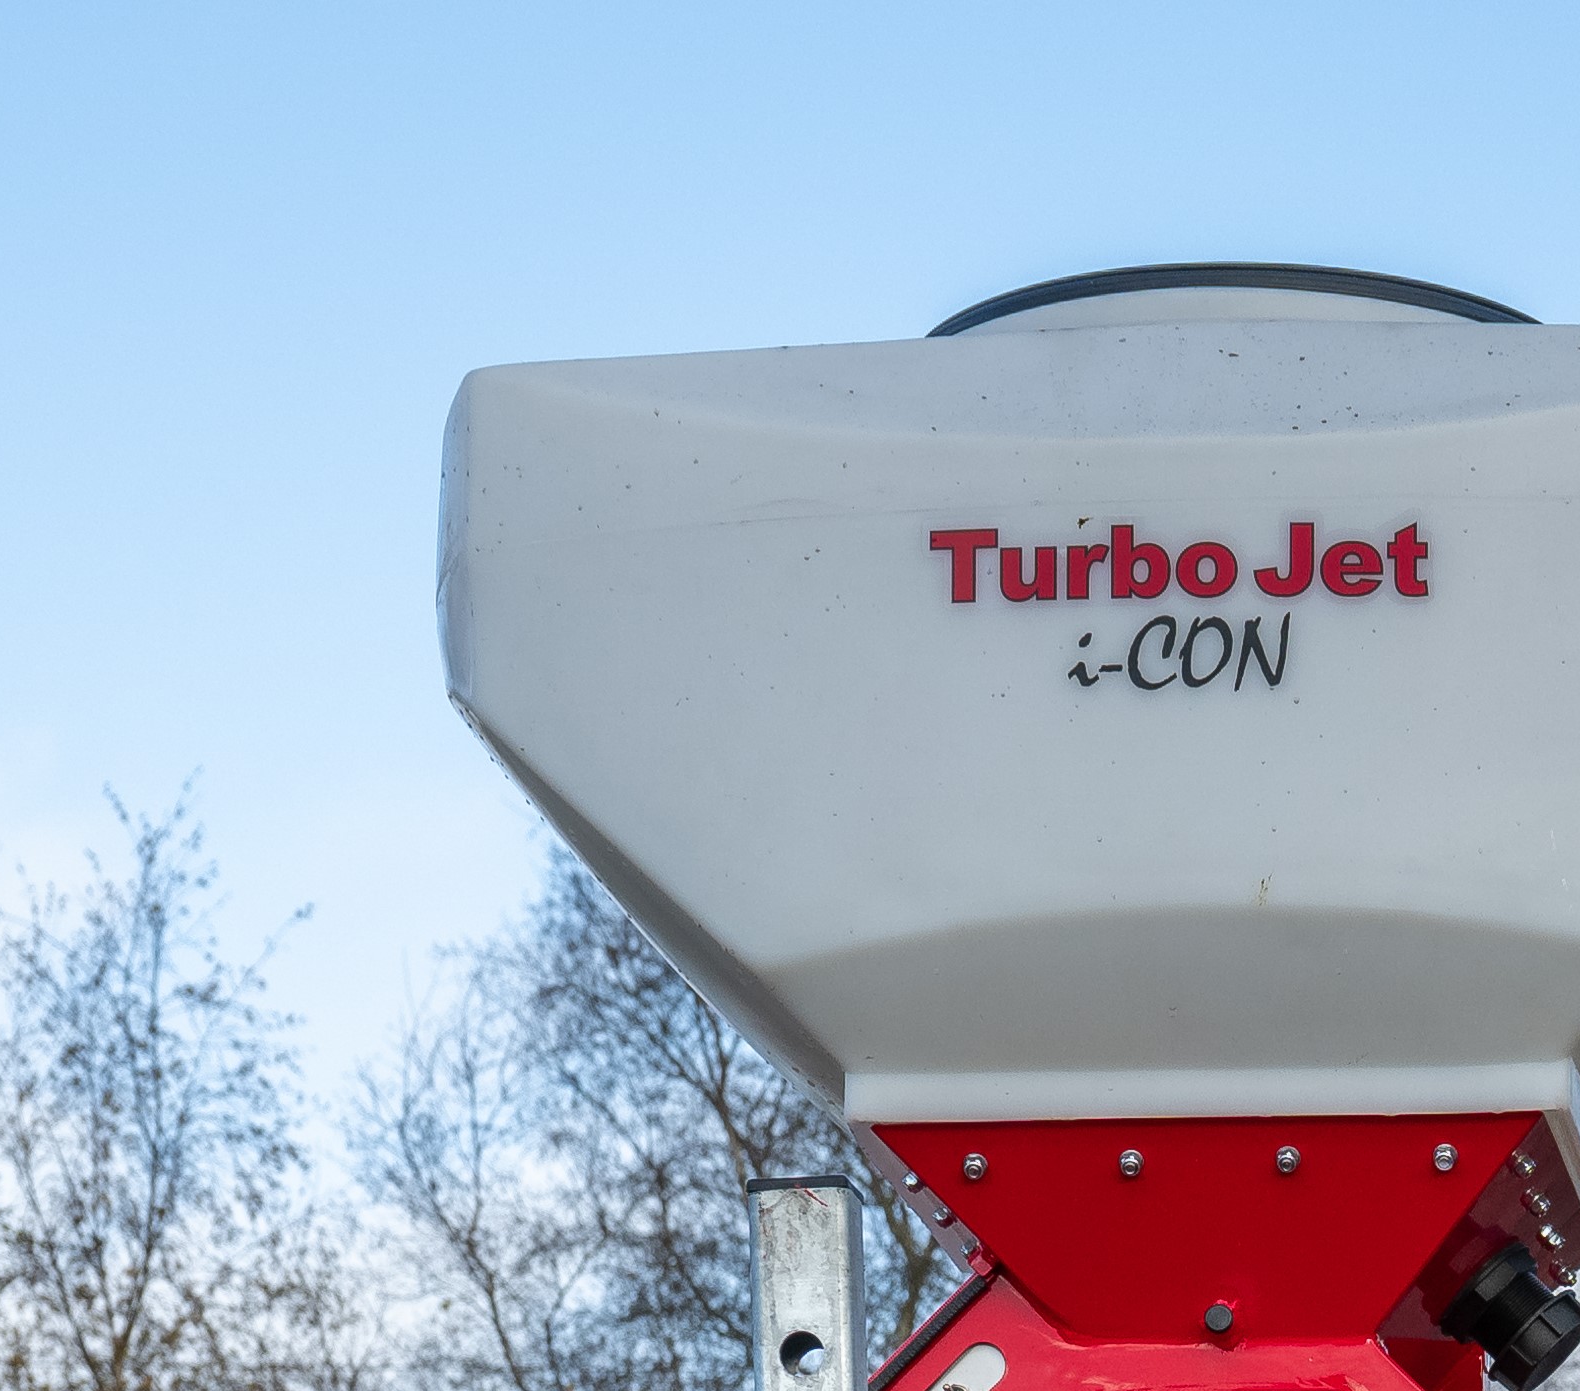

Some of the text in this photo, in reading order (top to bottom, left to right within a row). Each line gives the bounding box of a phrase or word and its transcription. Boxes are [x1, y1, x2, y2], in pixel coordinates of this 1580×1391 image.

[929, 521, 1430, 603] Turbo Jet
[1067, 611, 1290, 692] i-CON
